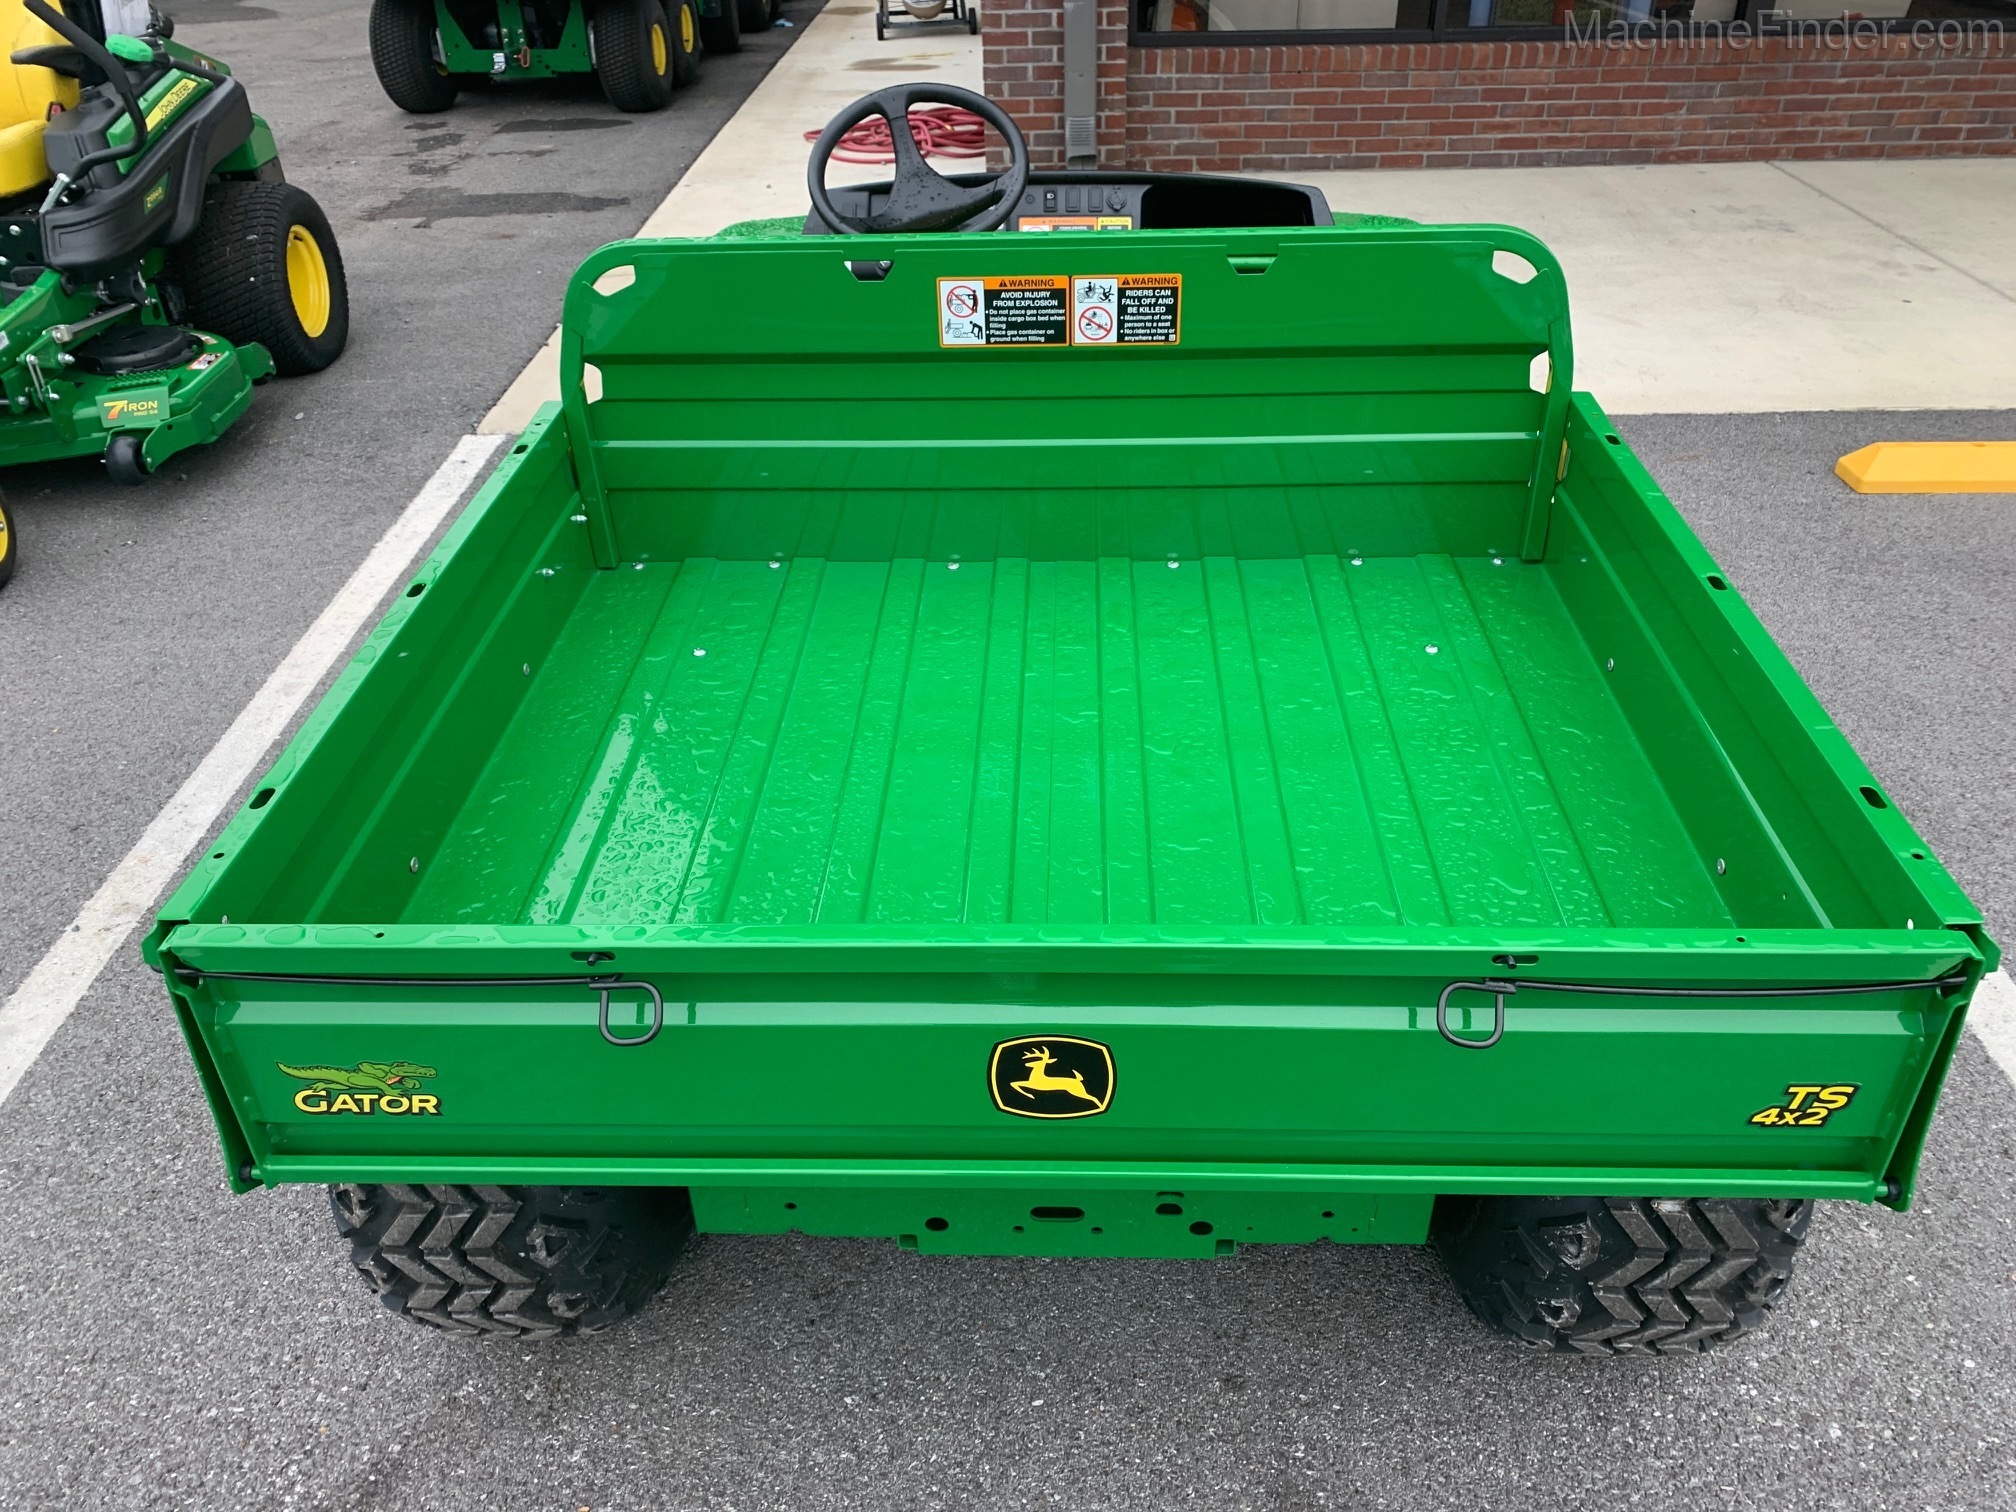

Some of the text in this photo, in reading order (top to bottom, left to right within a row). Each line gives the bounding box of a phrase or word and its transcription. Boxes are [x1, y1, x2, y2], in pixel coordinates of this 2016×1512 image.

[158, 82, 191, 116] JOHN DEERE
[1008, 279, 1054, 287] WARNING
[1132, 277, 1178, 285] WARNING
[294, 1089, 439, 1114] GATOR
[1788, 1086, 1855, 1110] TS
